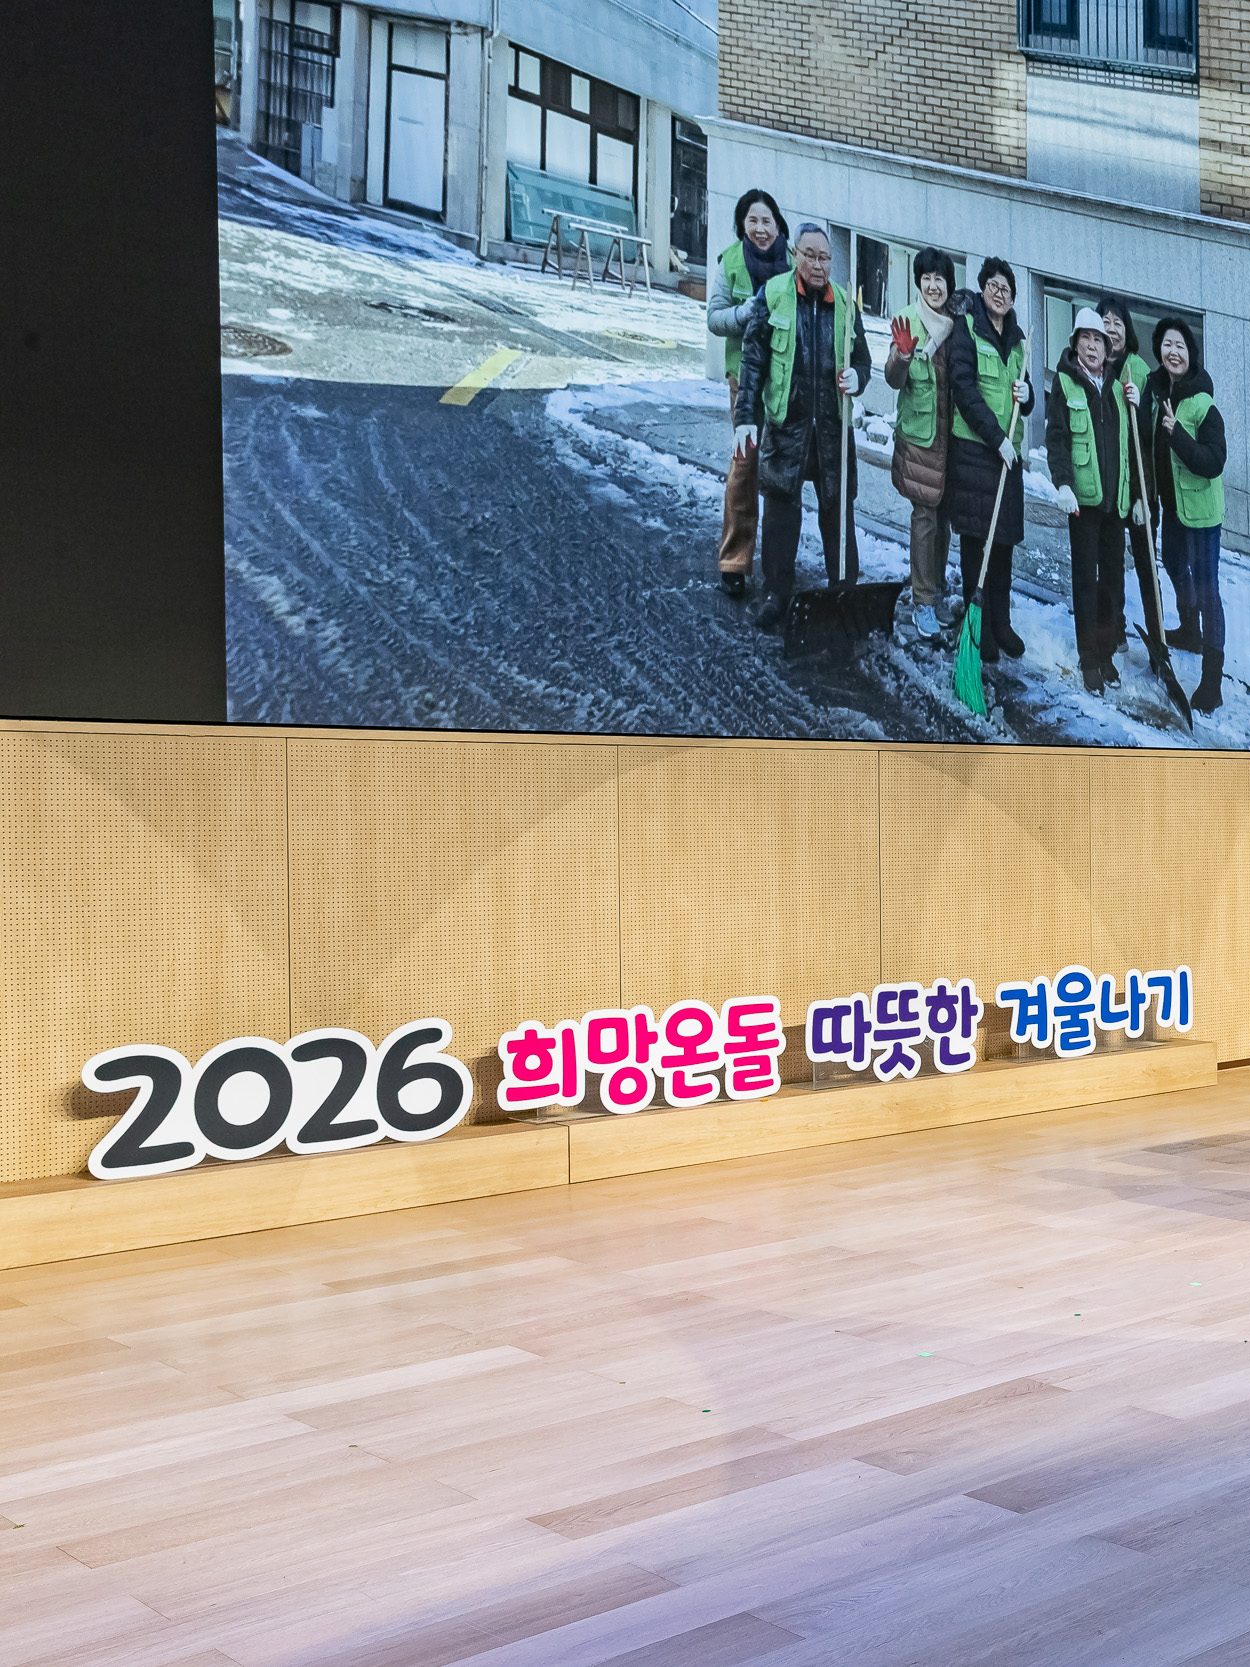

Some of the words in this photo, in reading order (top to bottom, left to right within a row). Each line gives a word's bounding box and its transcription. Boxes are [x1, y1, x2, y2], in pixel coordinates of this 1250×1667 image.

[94, 1027, 464, 1169] 2026
[505, 1003, 781, 1106] 희망온돌
[812, 984, 978, 1078] 따뜻한
[1001, 970, 1190, 1051] 겨울나기
